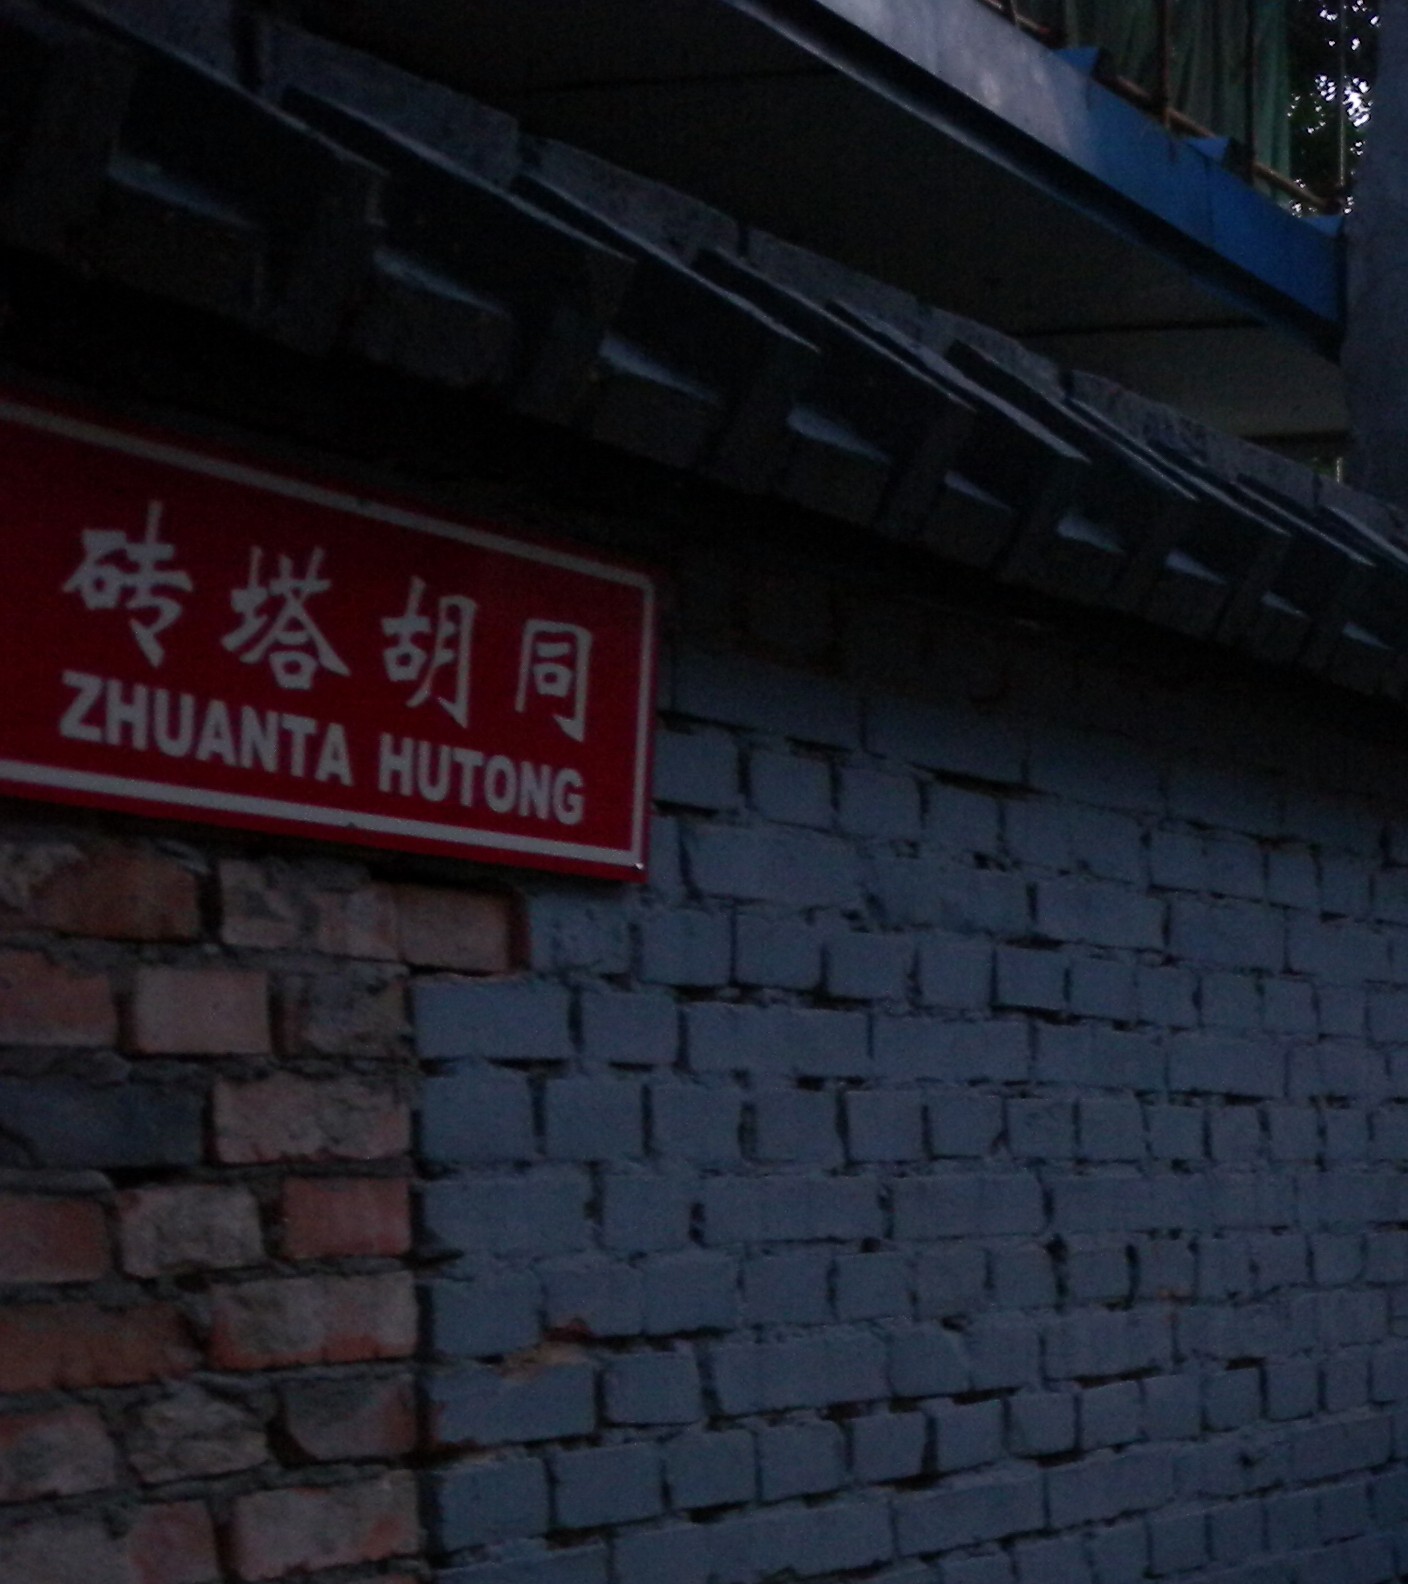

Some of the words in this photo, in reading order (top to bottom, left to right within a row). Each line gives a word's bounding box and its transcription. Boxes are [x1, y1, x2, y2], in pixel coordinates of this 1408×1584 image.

[60, 498, 594, 744] 砖塔胡同
[58, 668, 355, 788] ZHUANTA
[377, 731, 587, 826] HUTONG
